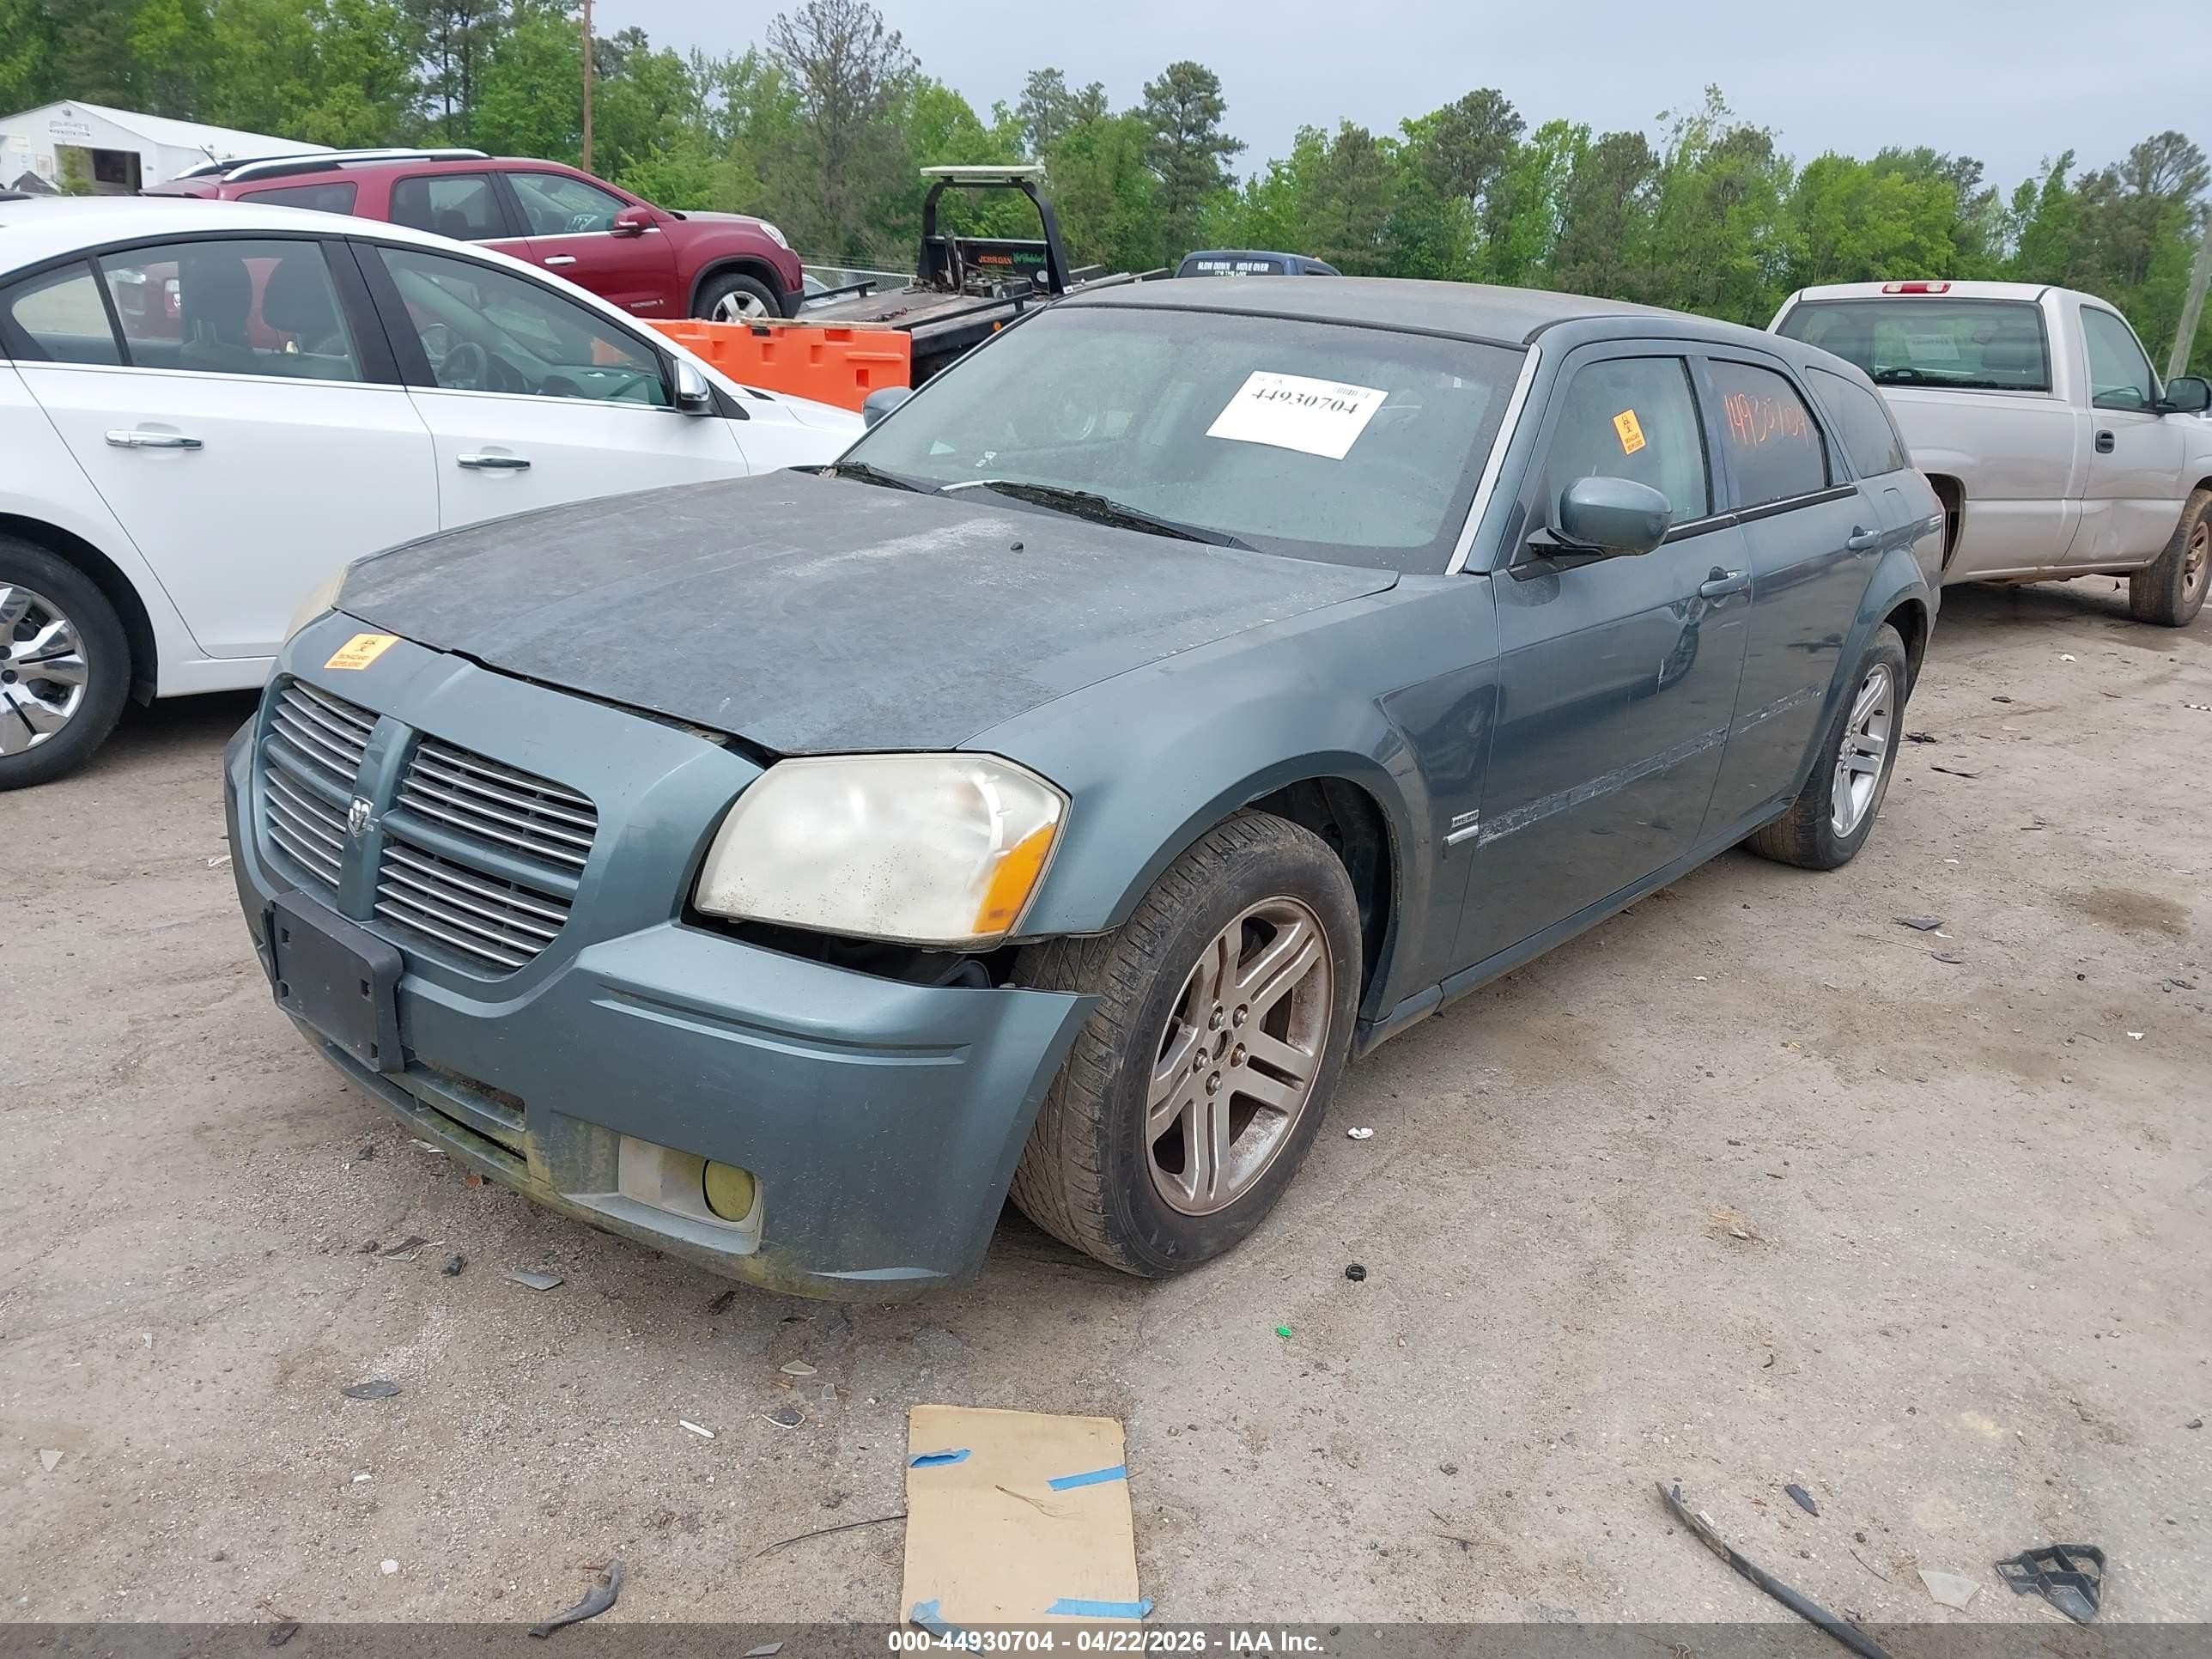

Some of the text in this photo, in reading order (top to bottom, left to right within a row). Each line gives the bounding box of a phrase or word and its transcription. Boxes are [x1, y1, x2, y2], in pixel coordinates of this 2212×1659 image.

[1197, 261, 1270, 271] SLOW DOWN MOVE OVER
[1251, 387, 1359, 415] 44930704
